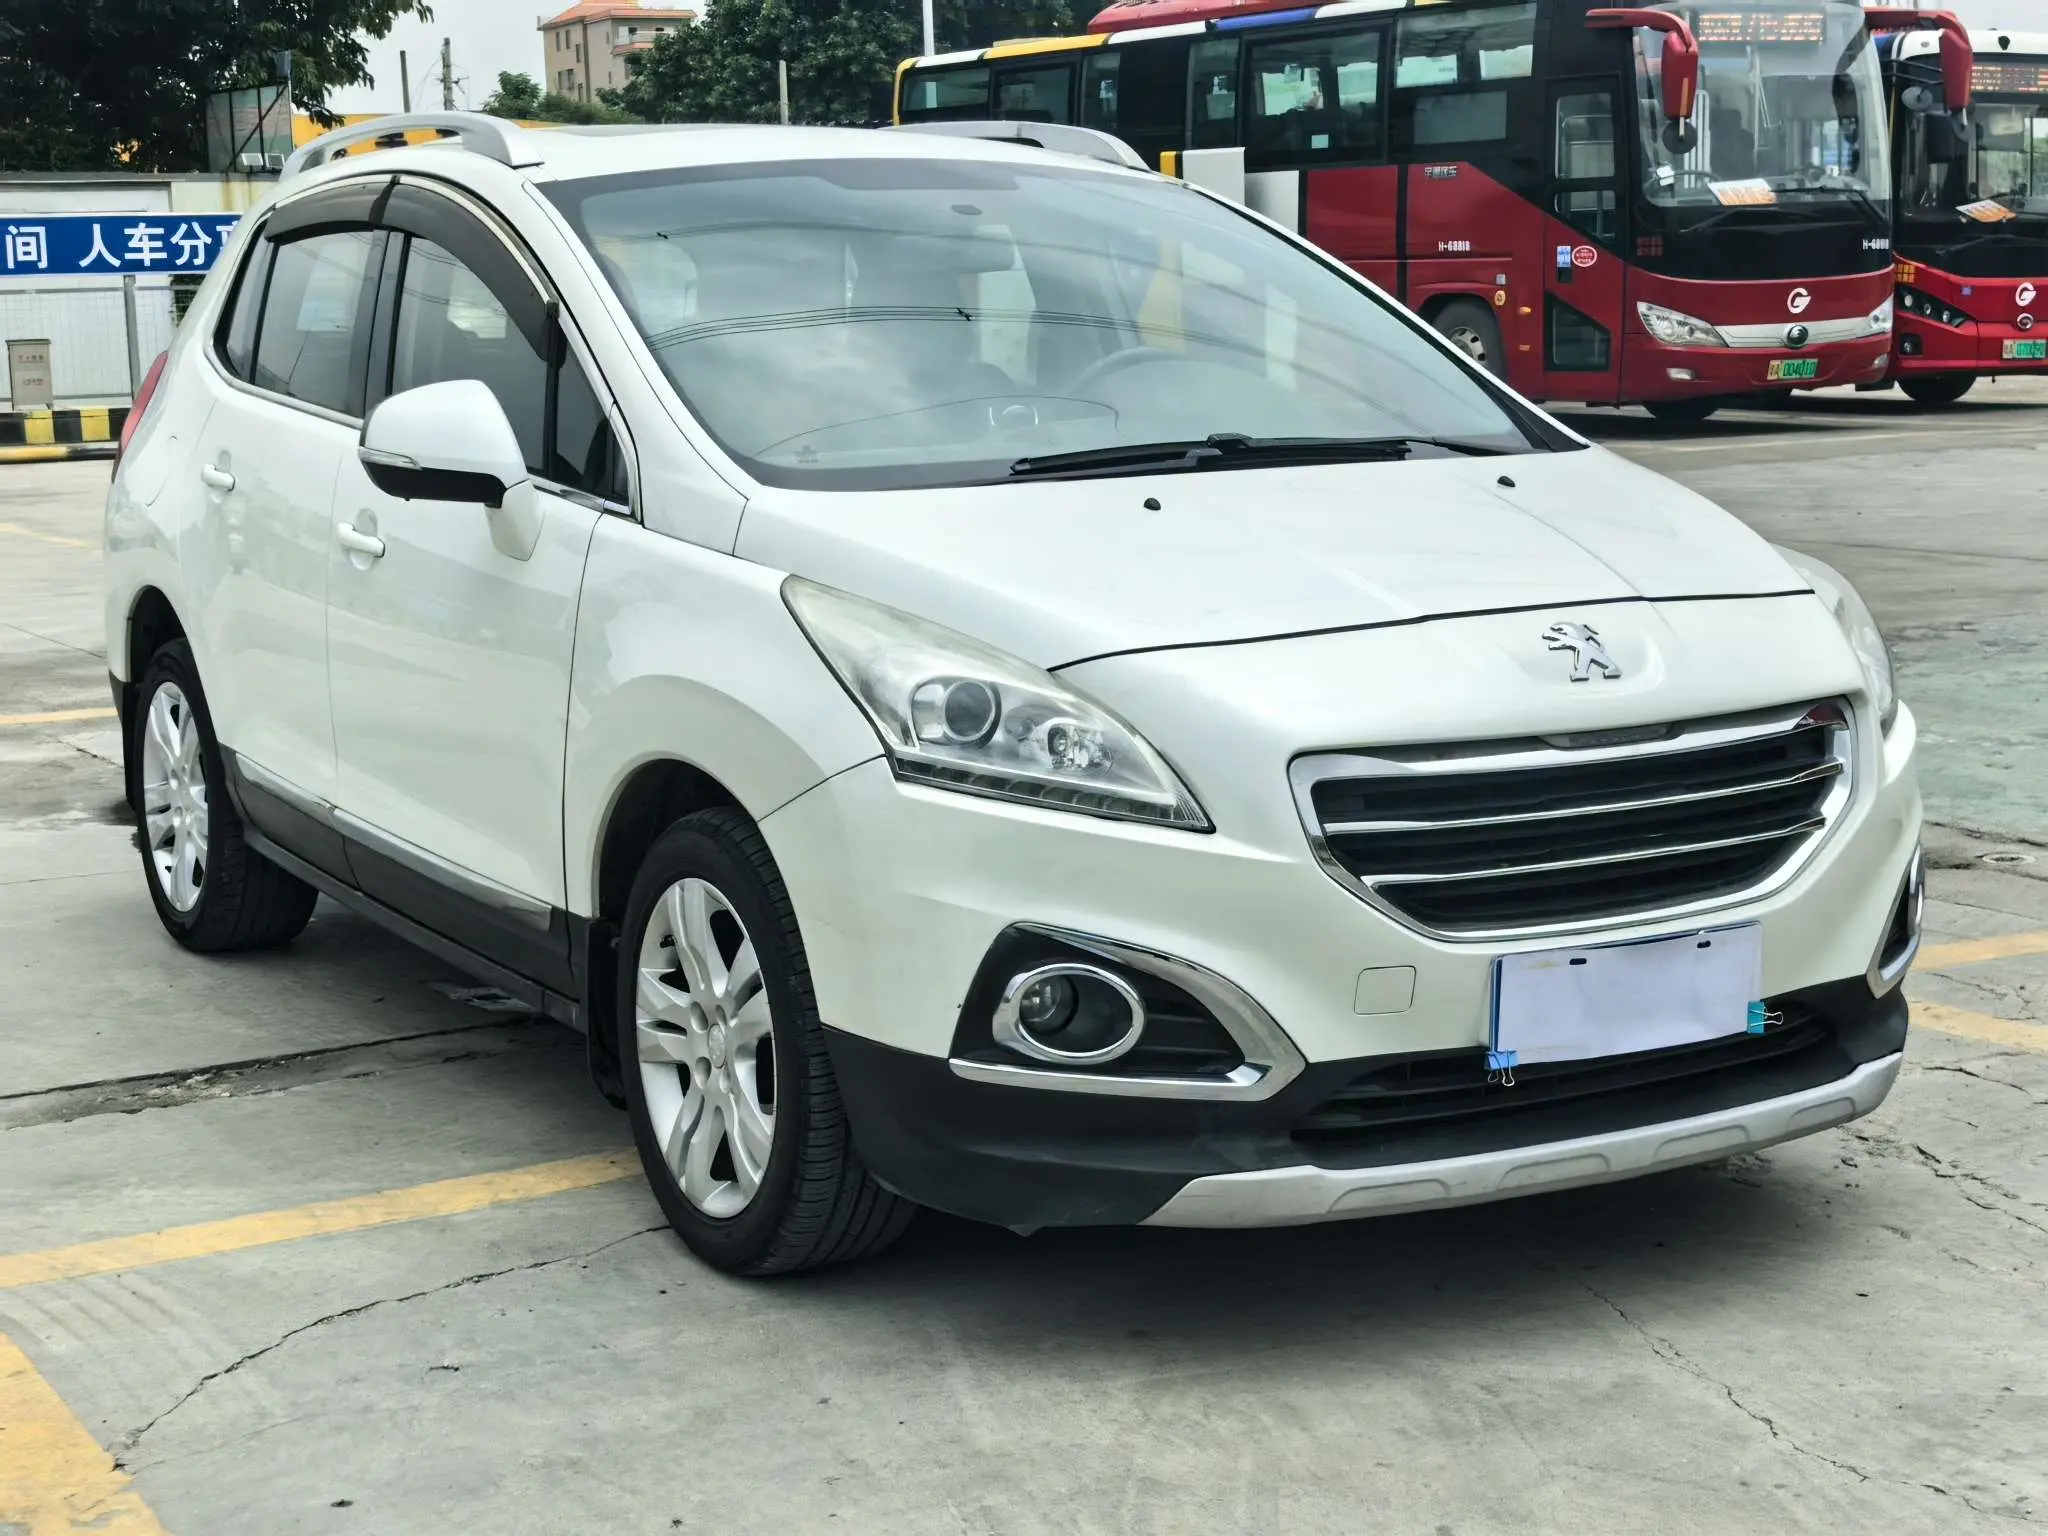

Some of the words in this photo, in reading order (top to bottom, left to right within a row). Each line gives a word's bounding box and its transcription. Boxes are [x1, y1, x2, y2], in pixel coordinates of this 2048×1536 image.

[5, 224, 48, 269] 间
[78, 221, 239, 268] 人车分
